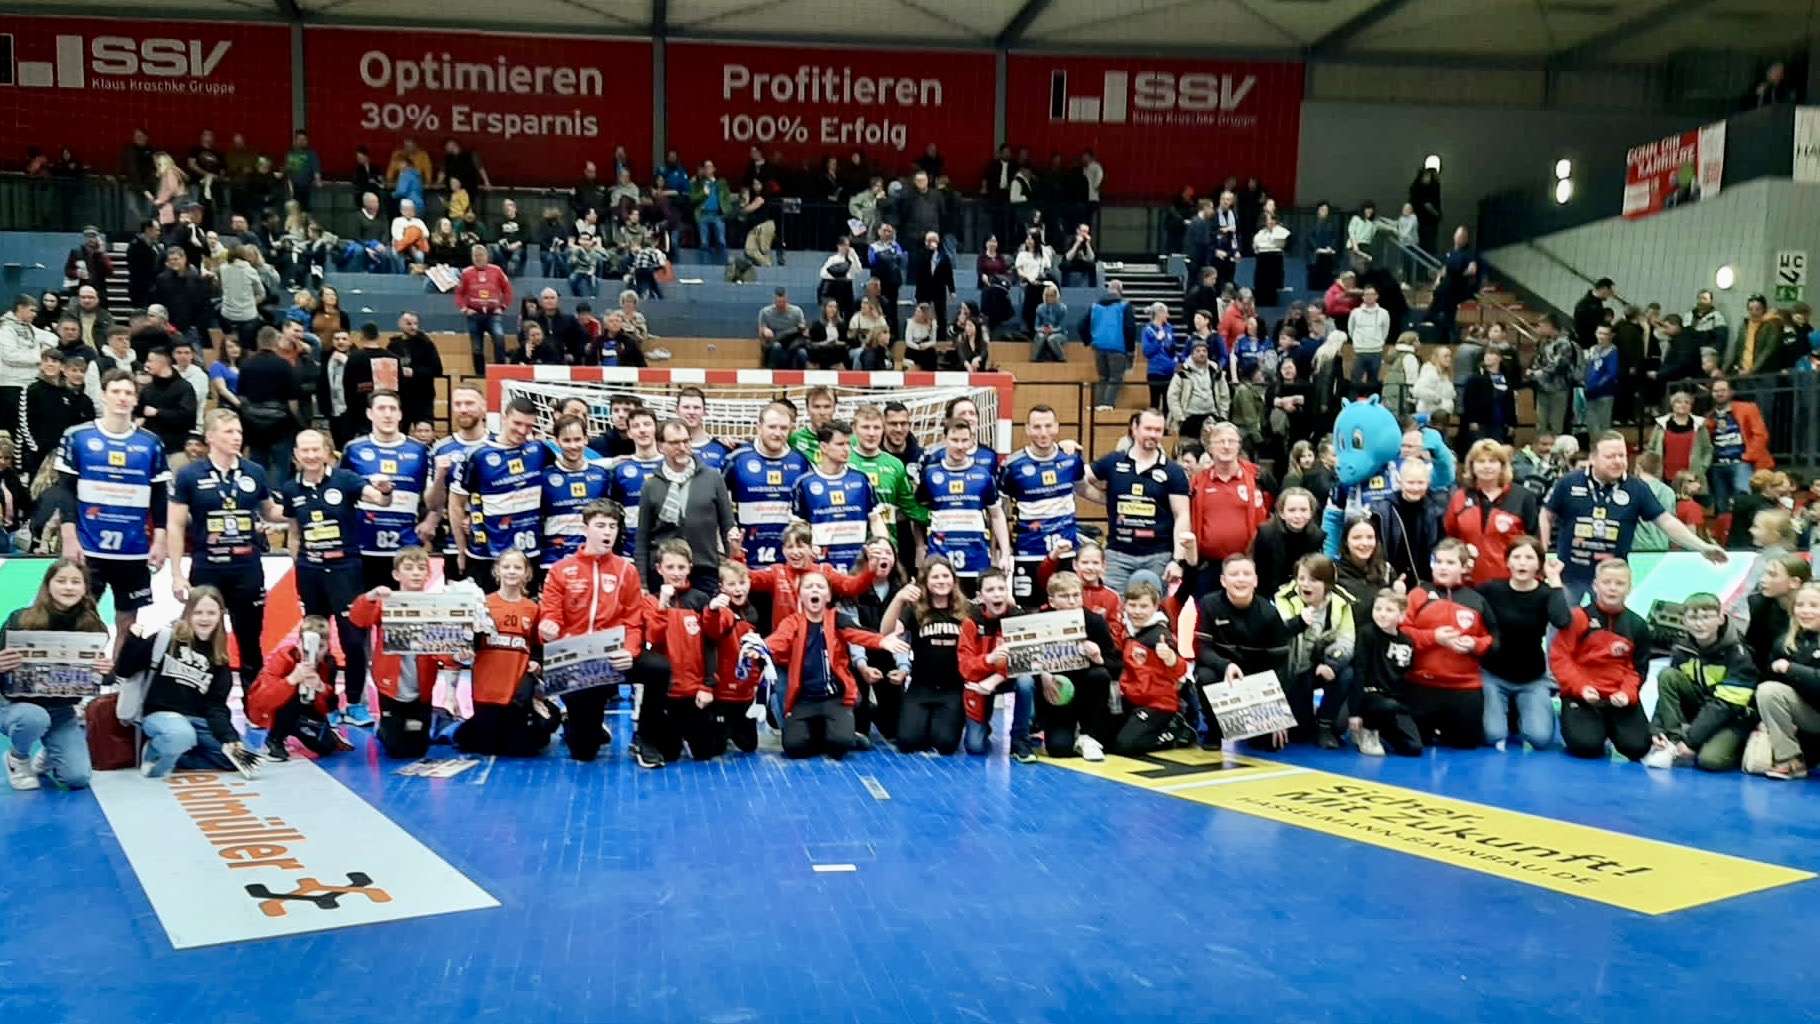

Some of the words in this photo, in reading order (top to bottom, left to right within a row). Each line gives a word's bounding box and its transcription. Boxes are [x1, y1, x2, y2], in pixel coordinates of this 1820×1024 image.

[91, 35, 233, 77] SSV
[359, 50, 604, 98] Optimieren
[91, 77, 126, 91] Klaus
[130, 79, 186, 93] Kroschke
[189, 81, 236, 95] Gruppe
[722, 63, 944, 108] Profitieren
[1133, 70, 1258, 111] SSV
[359, 102, 440, 131] 30%
[452, 106, 600, 141] Ersparnis
[719, 114, 809, 144] 100%
[820, 116, 908, 151] Erfolg
[376, 530, 401, 549] 82
[513, 530, 537, 550] 66
[503, 614, 518, 627] 20
[919, 622, 961, 639] ALIFORN
[163, 772, 307, 870] eidmüller
[1315, 785, 1485, 824] Sicher.
[1271, 790, 1371, 814] Mit
[1368, 811, 1653, 877] Zukunft!
